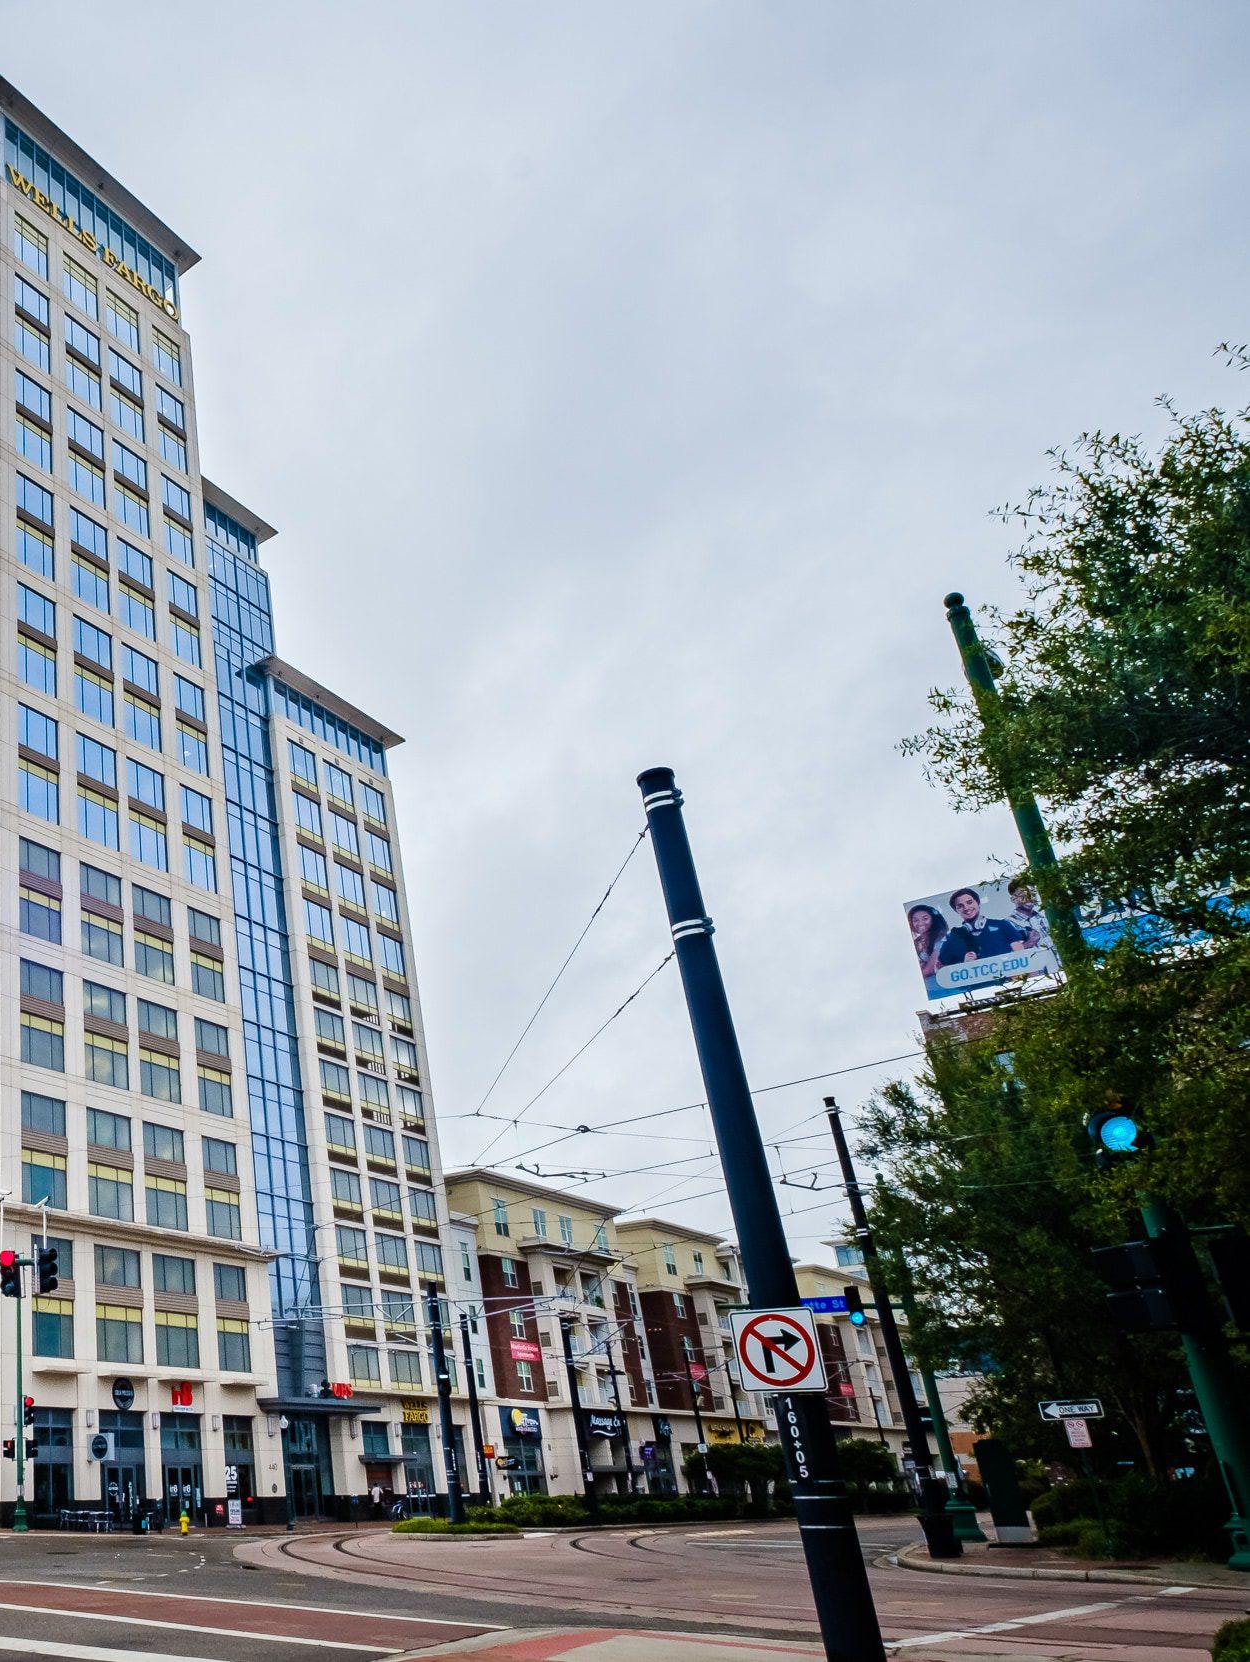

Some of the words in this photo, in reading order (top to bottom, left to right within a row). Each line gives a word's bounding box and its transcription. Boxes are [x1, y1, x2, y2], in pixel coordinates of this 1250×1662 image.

[6, 162, 97, 254] WELLS
[103, 247, 179, 321] FARGO
[950, 957, 1029, 982] GO.TCCEDU
[831, 1299, 845, 1309] St
[332, 1382, 354, 1398] UBS
[402, 1400, 427, 1410] WELLS
[1058, 1406, 1076, 1414] ONE
[1077, 1404, 1095, 1412] WAY
[403, 1410, 428, 1423] FARGO
[784, 1397, 810, 1478] 160+05
[225, 1465, 238, 1481] 25
